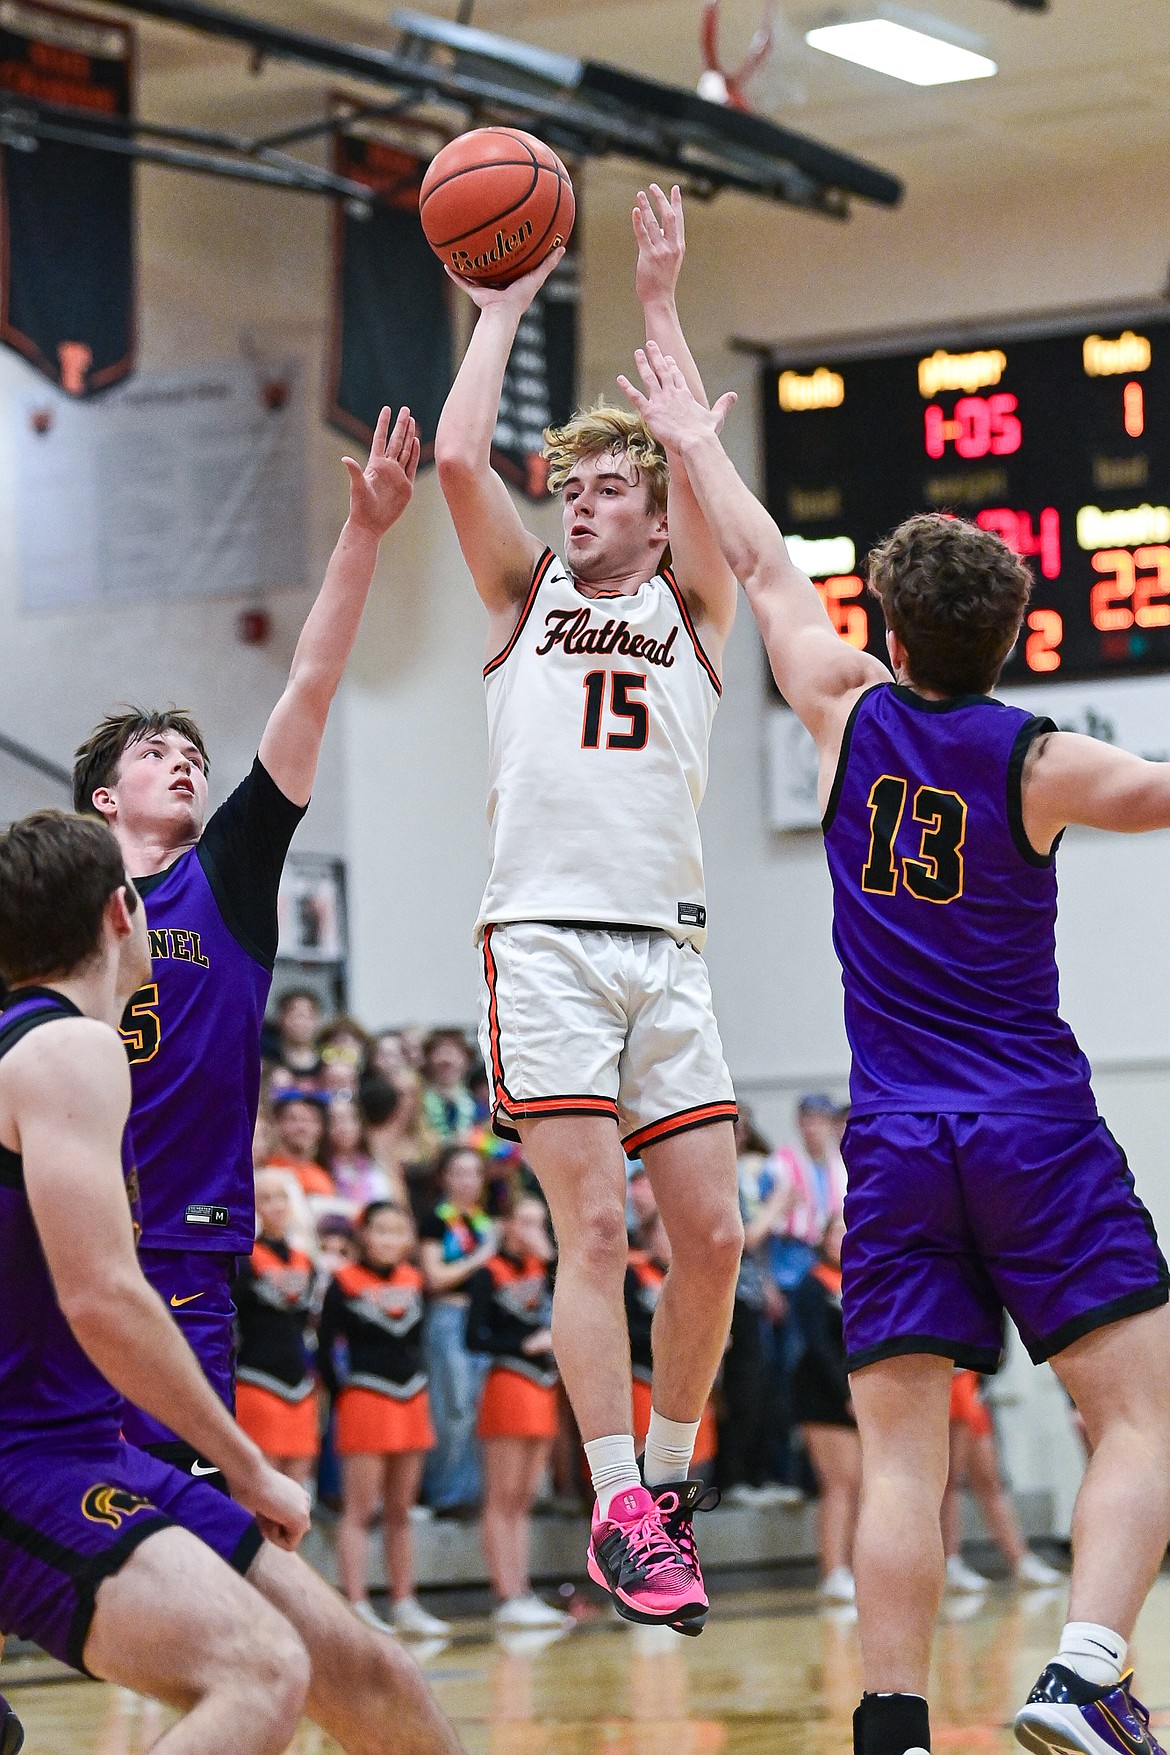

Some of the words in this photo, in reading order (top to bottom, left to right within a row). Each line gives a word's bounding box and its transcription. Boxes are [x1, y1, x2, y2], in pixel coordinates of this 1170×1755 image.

[451, 219, 533, 271] Baden
[1090, 546, 1170, 632] 22
[536, 607, 678, 668] Flathead
[1026, 609, 1063, 672] 2
[581, 669, 649, 750] 15
[862, 774, 968, 904] 13
[215, 1211, 224, 1221] M
